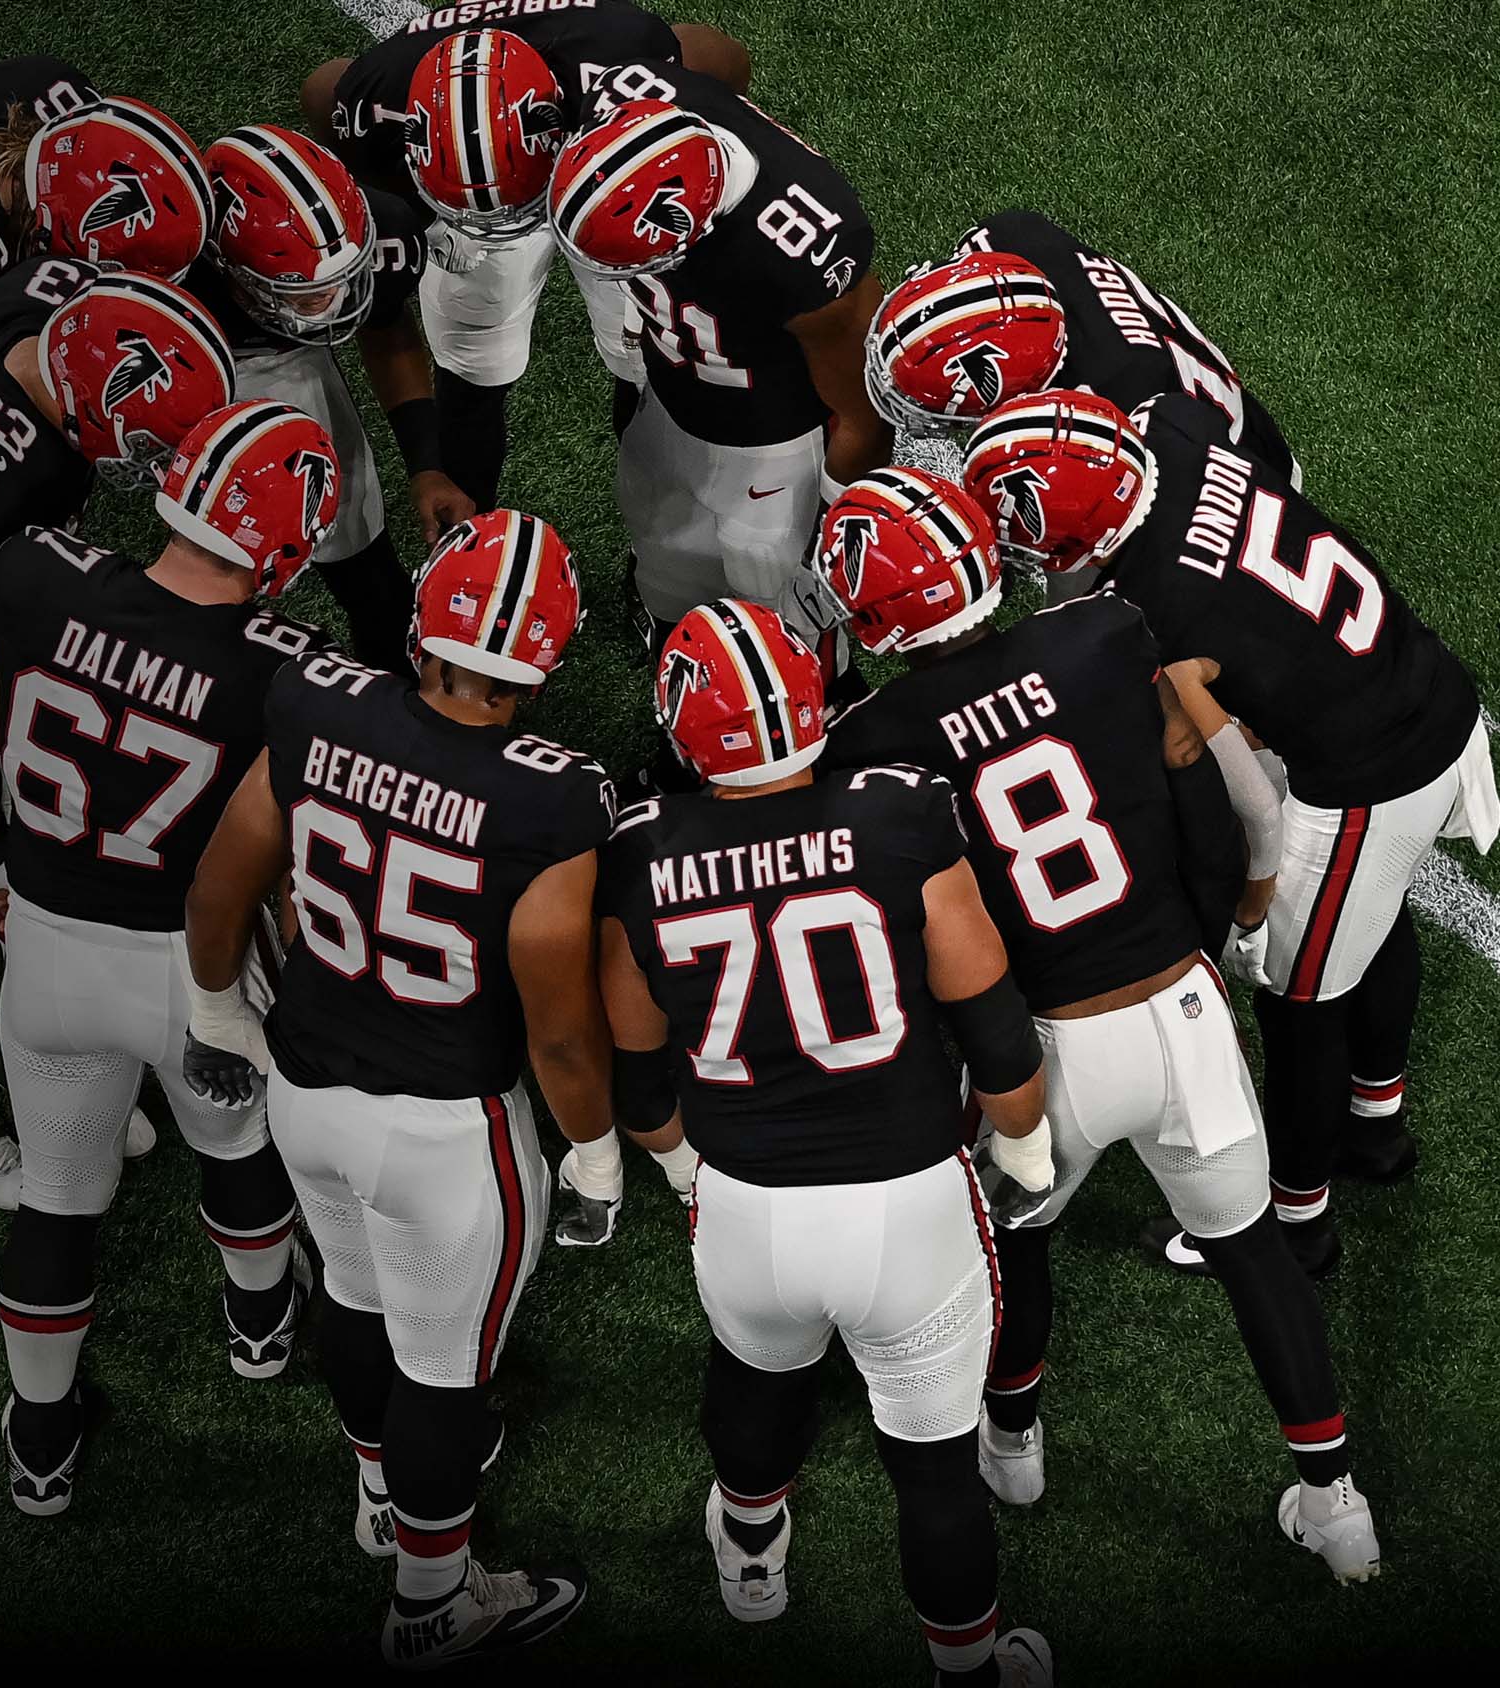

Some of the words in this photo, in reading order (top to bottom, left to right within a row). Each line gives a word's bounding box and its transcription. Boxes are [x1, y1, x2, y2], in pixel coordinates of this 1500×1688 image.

[756, 183, 844, 258] 81
[1075, 252, 1162, 349] HODGE
[240, 514, 257, 529] 67
[1178, 445, 1254, 580] LONDON
[1238, 488, 1386, 657] 5
[53, 618, 216, 722] DALMAN
[939, 672, 1057, 760] PITTS
[0, 665, 225, 871] 67
[302, 736, 486, 848] BERGERON
[649, 827, 855, 907] MATTHEWS
[971, 733, 1134, 934] 8
[290, 795, 485, 1008] 65
[653, 886, 908, 1086] 70
[392, 1606, 459, 1660] NIKE
